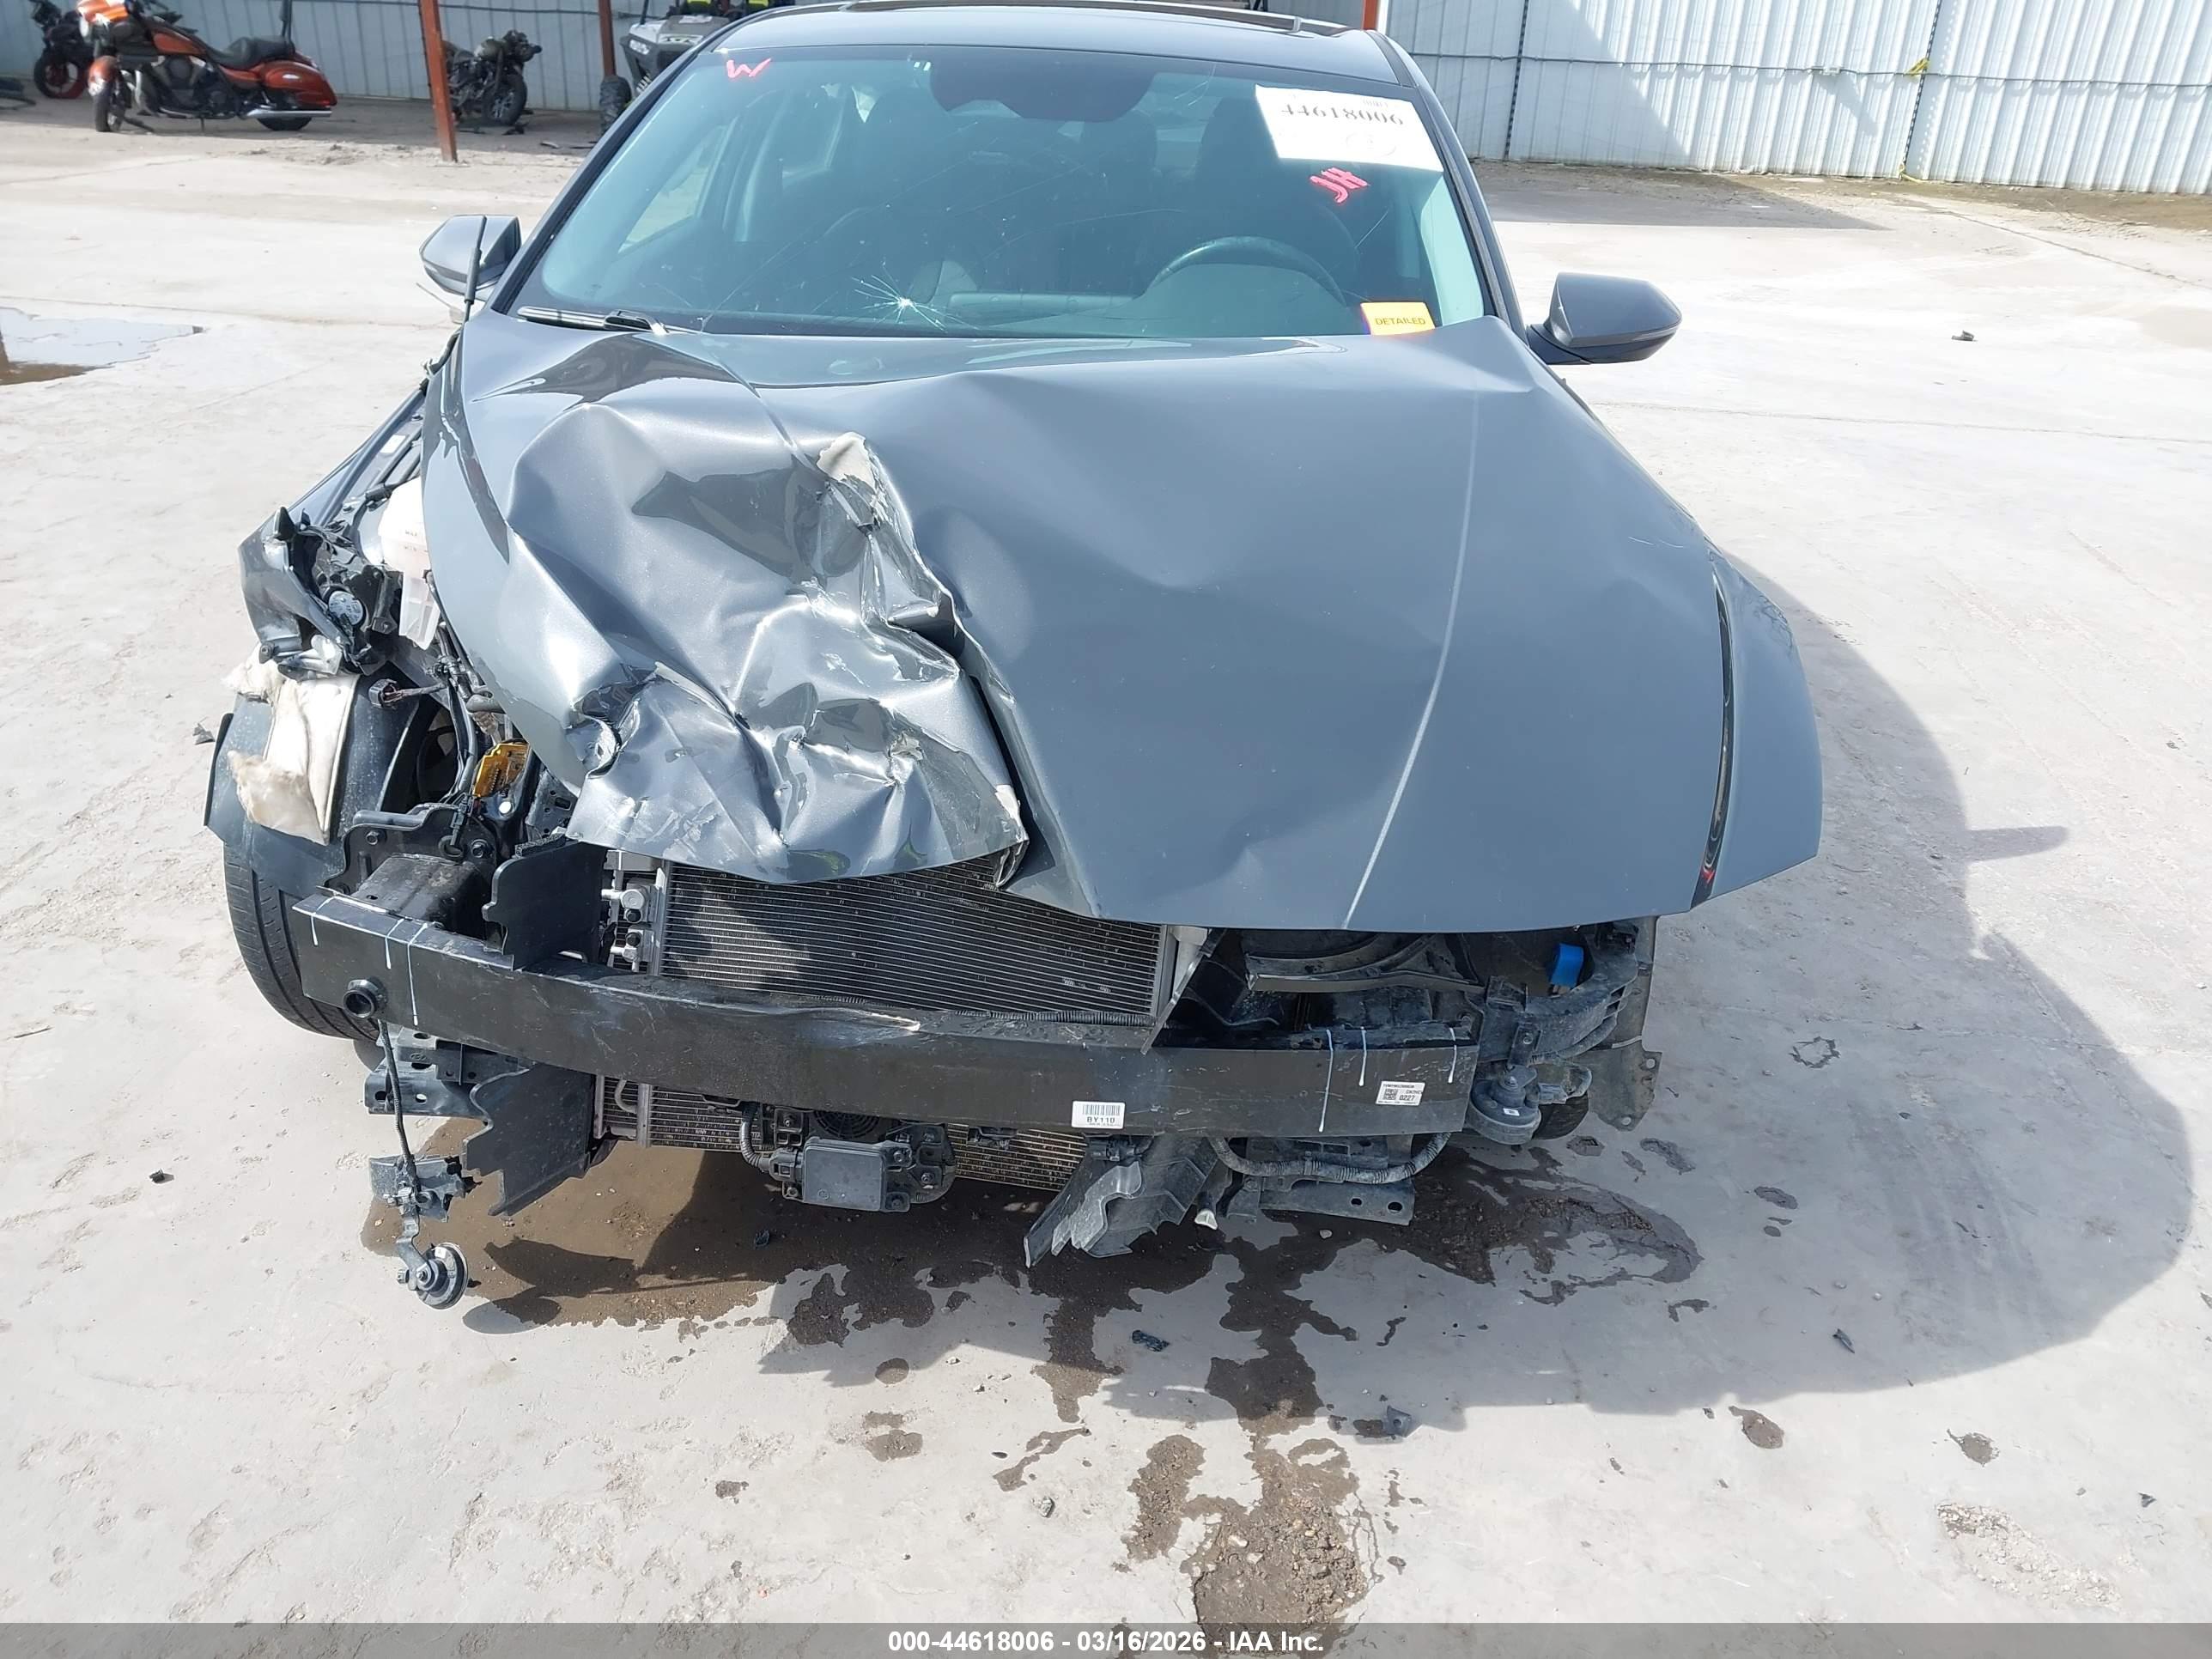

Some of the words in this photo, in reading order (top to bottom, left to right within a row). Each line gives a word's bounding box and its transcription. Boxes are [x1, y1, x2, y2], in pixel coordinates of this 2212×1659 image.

[726, 58, 771, 79] W
[1281, 103, 1404, 125] 44618006
[1375, 317, 1425, 325] DETAILED
